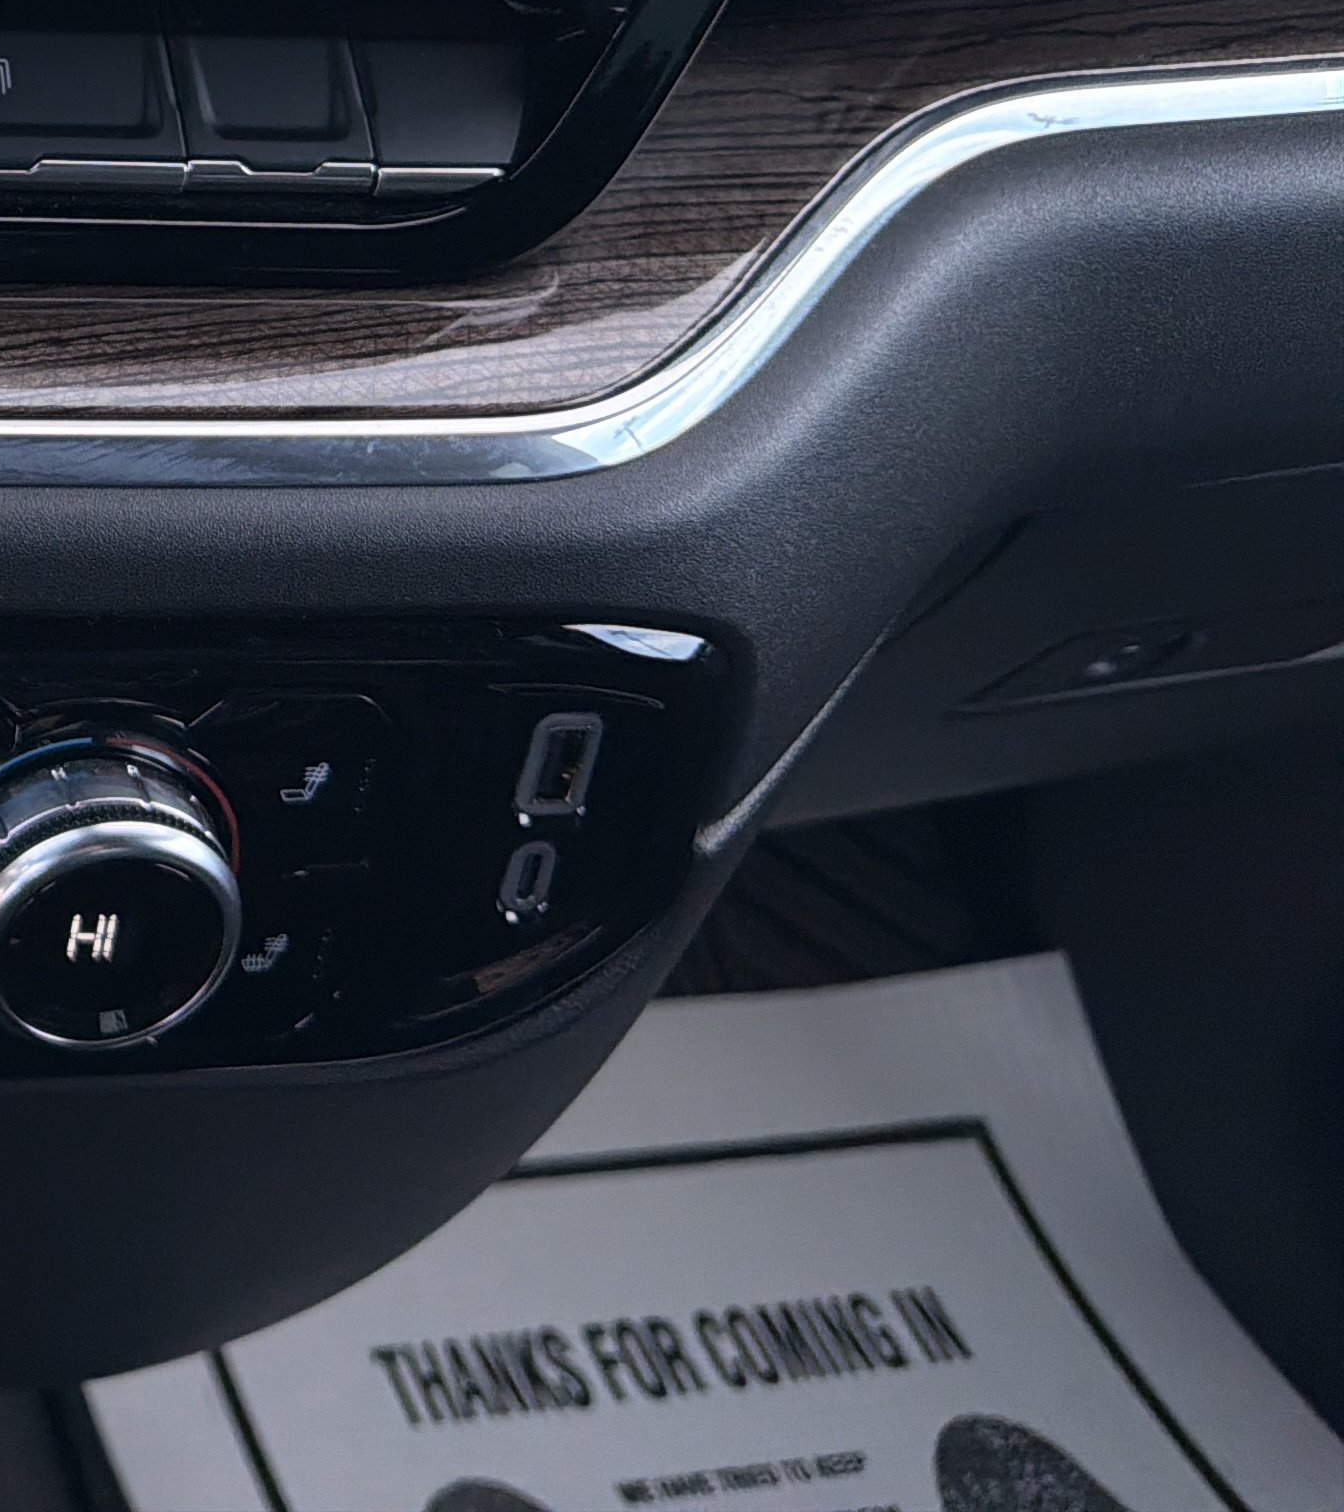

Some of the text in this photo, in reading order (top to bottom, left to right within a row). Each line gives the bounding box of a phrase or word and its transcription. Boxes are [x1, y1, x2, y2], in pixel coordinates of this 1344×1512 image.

[66, 912, 120, 963] HI
[370, 1285, 974, 1430] THANKS FOR COMING IN
